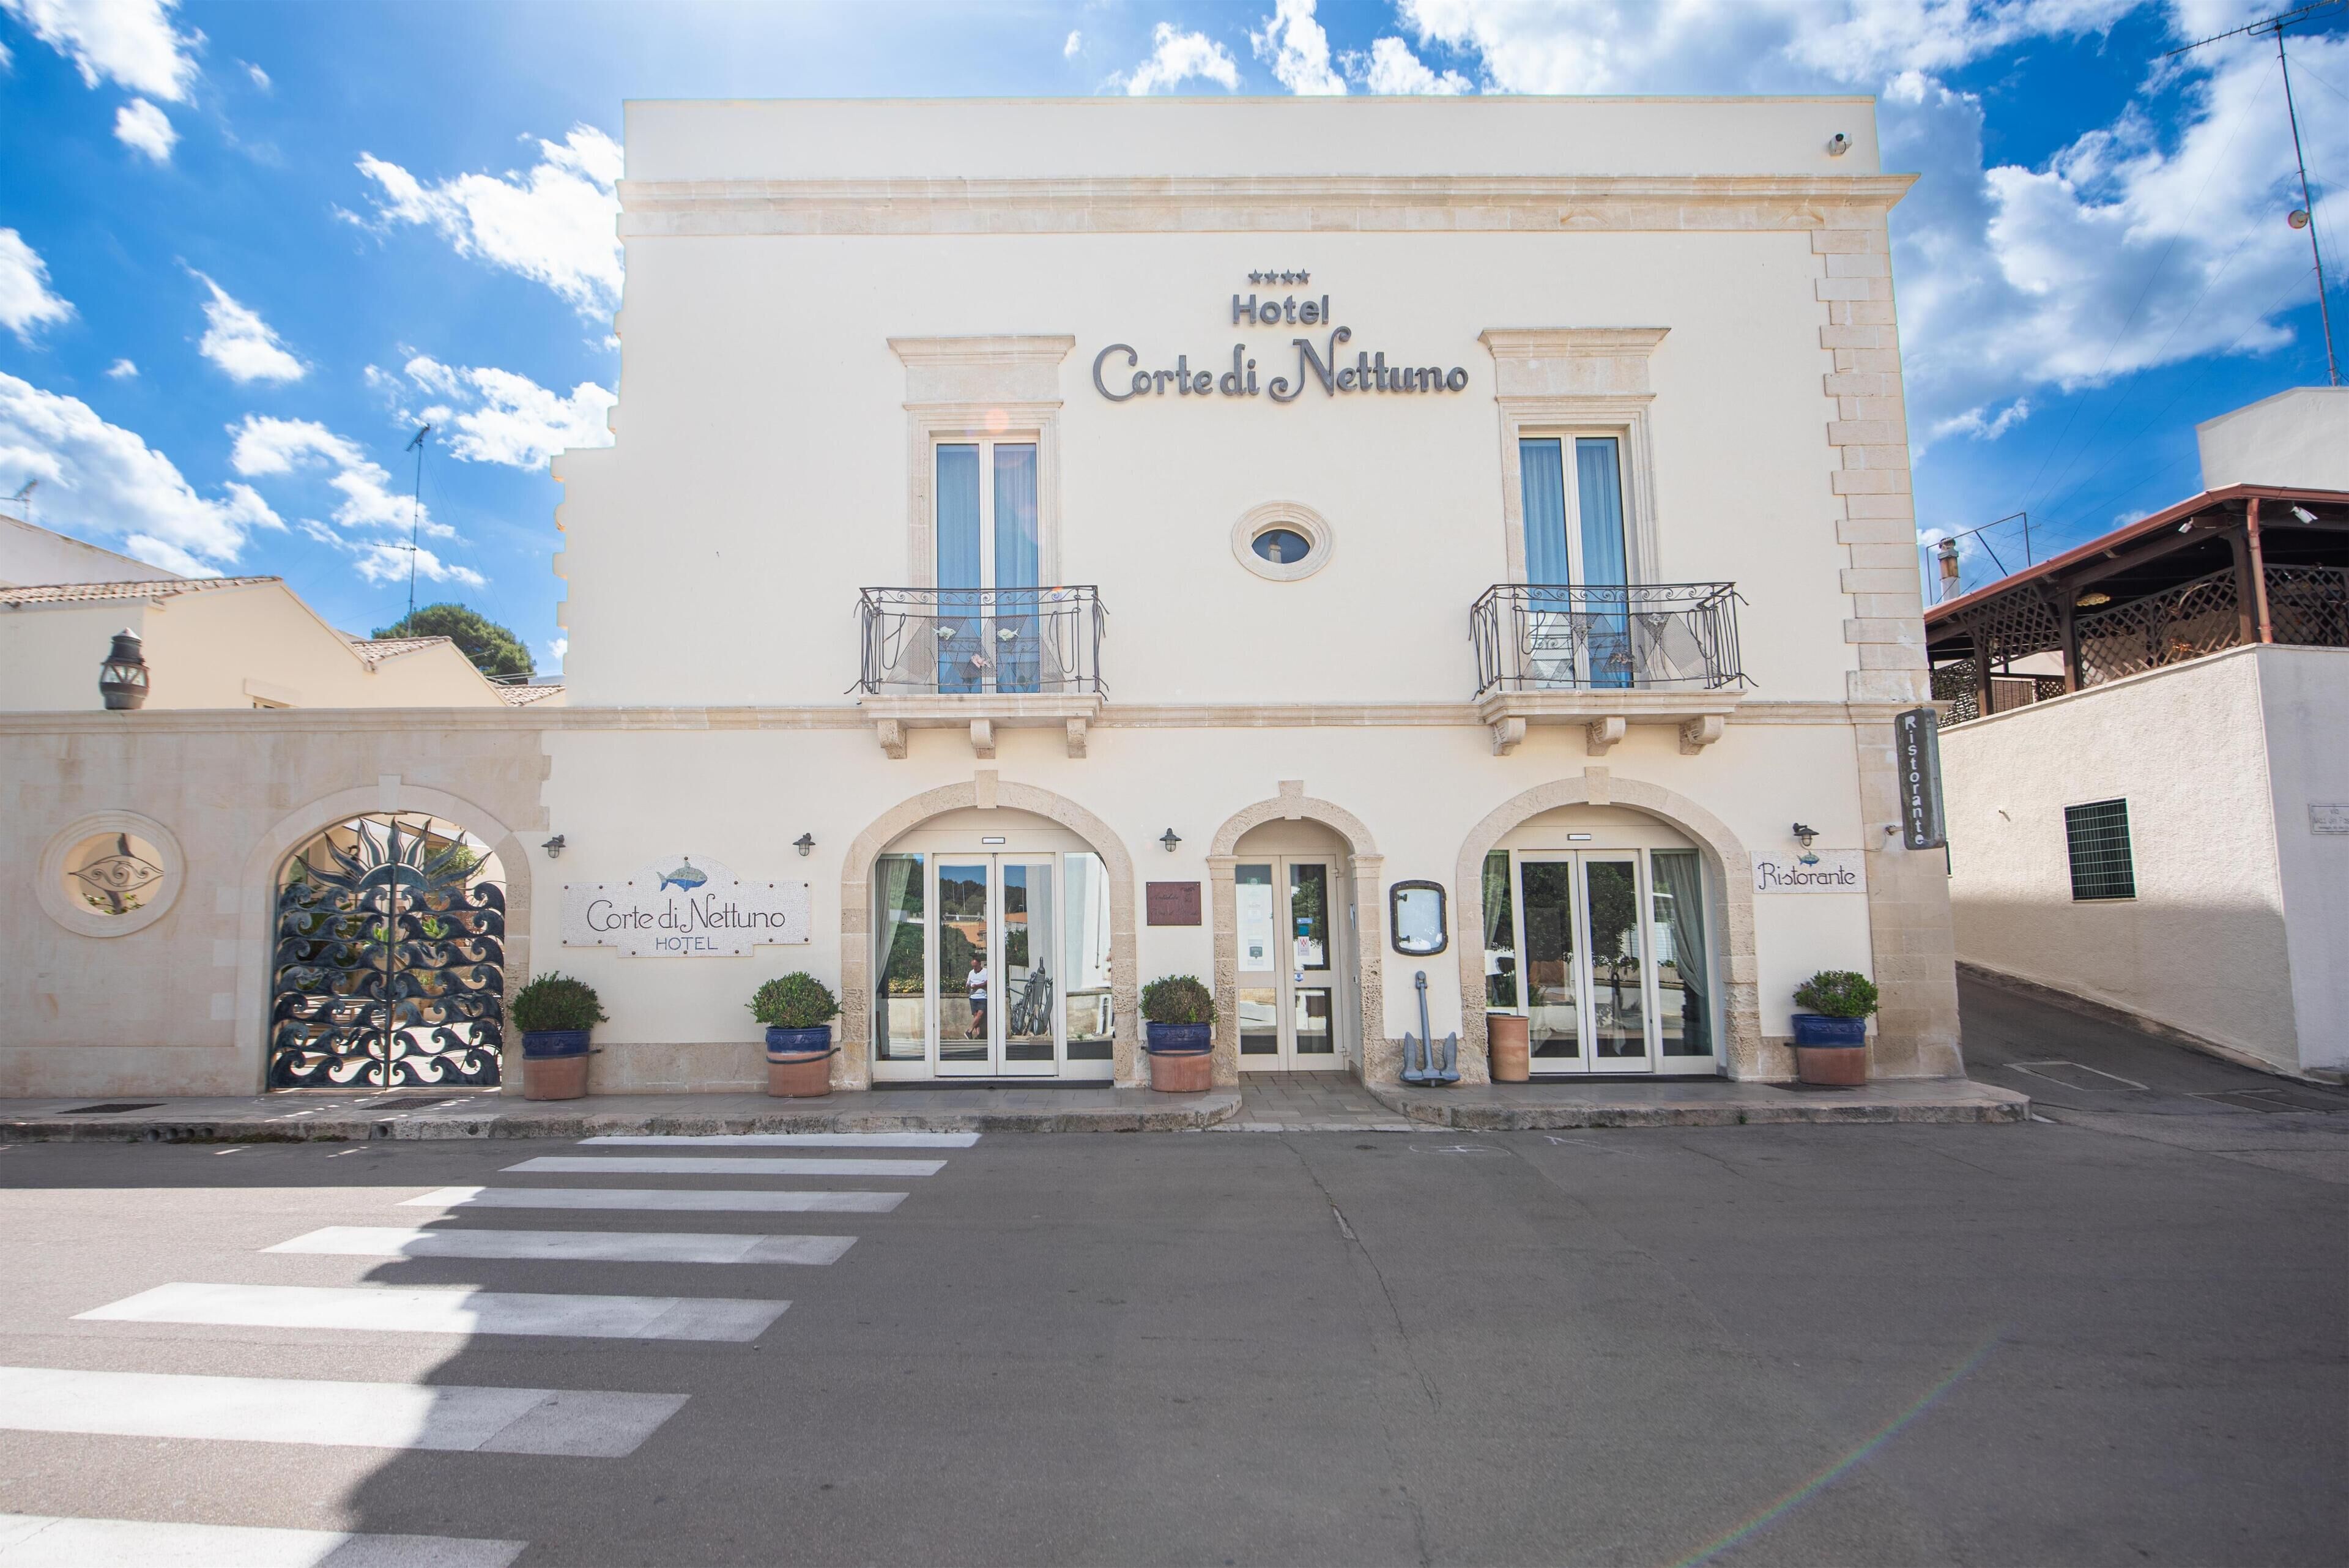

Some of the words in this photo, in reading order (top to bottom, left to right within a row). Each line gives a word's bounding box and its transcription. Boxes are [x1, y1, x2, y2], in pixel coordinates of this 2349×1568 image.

[1232, 294, 1329, 325] Hotel
[1093, 343, 1214, 402] Corte
[1220, 343, 1260, 396] di
[1269, 326, 1469, 403] Nettuno
[1904, 715, 1924, 845] Ristorante
[1757, 861, 1855, 890] Ristorante
[587, 900, 653, 932] Corte
[658, 898, 680, 929] di
[680, 894, 785, 933] Nettuno
[656, 937, 718, 950] HOTEL
